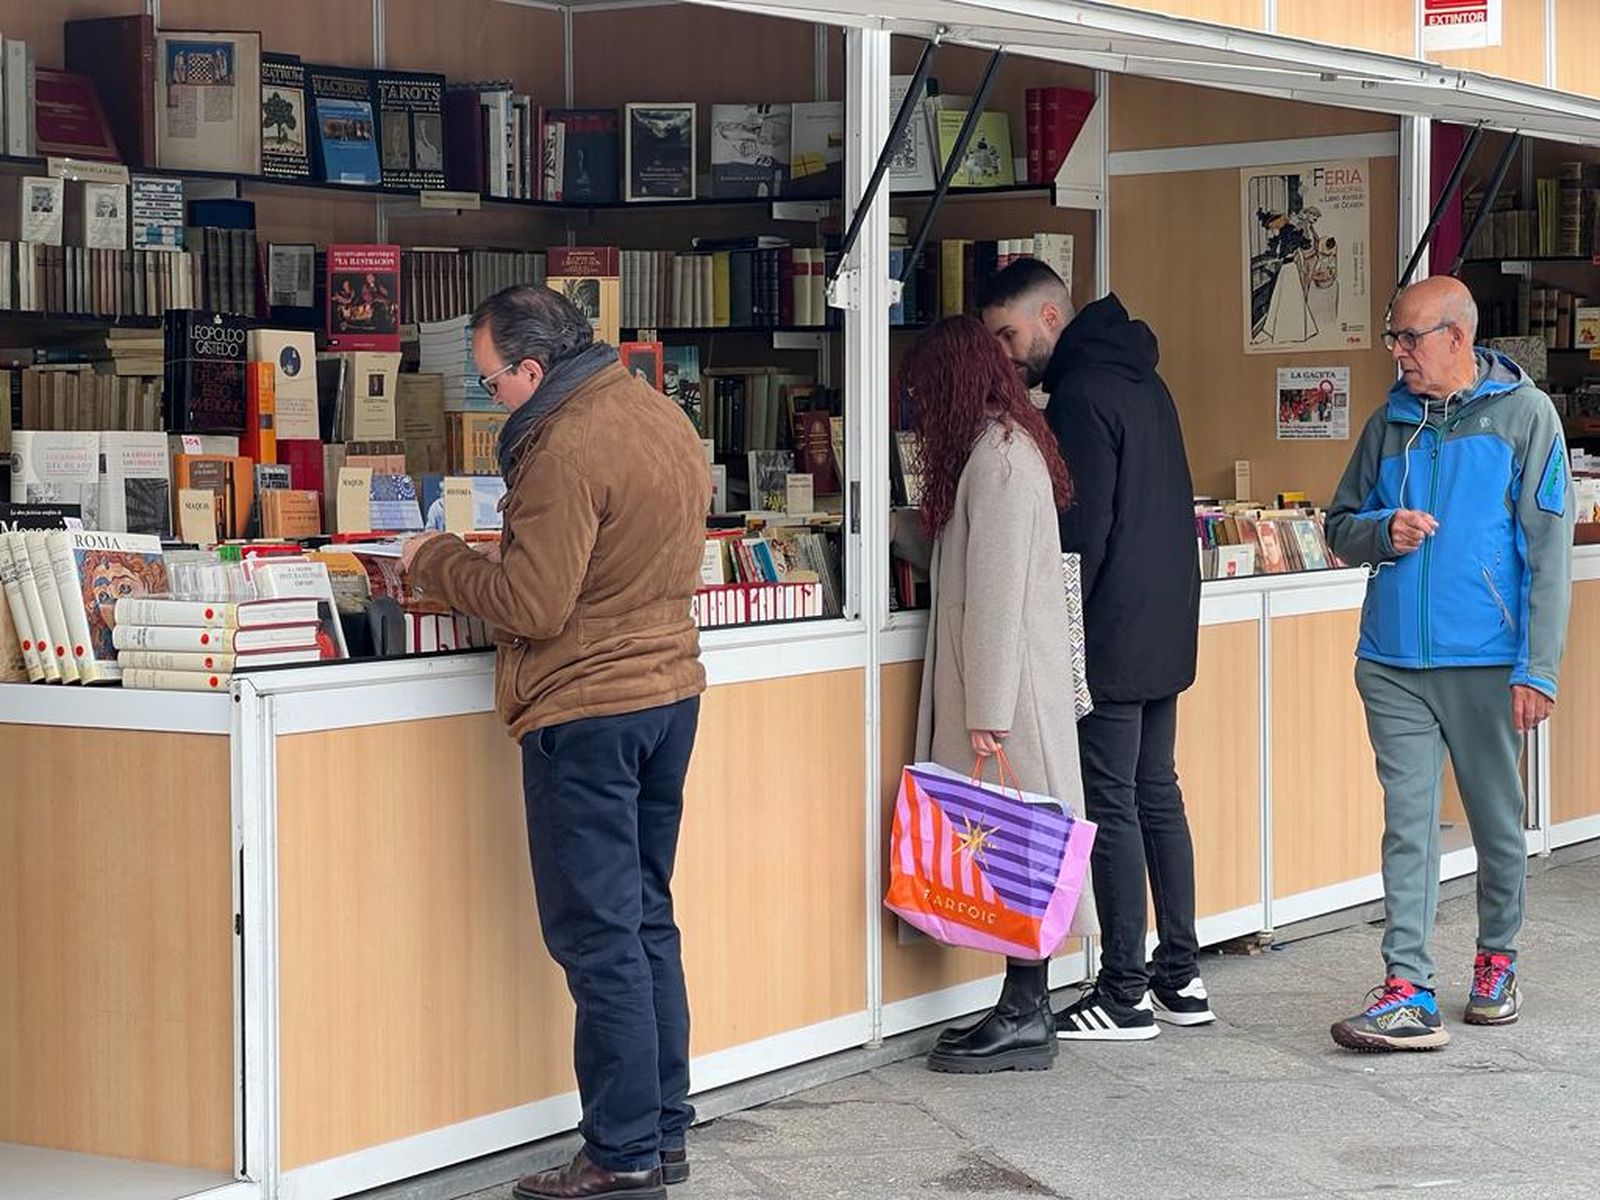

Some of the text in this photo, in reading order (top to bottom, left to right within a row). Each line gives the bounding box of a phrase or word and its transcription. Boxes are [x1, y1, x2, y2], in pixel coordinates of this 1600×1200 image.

[1429, 12, 1485, 25] EXTINTOR
[378, 85, 441, 101] TAROTS
[1313, 167, 1363, 187] FERIA
[190, 325, 245, 343] LEOPOLDO
[195, 340, 239, 356] CASTEDO
[1291, 371, 1336, 379] LA GACETA
[74, 533, 121, 551] ROMA
